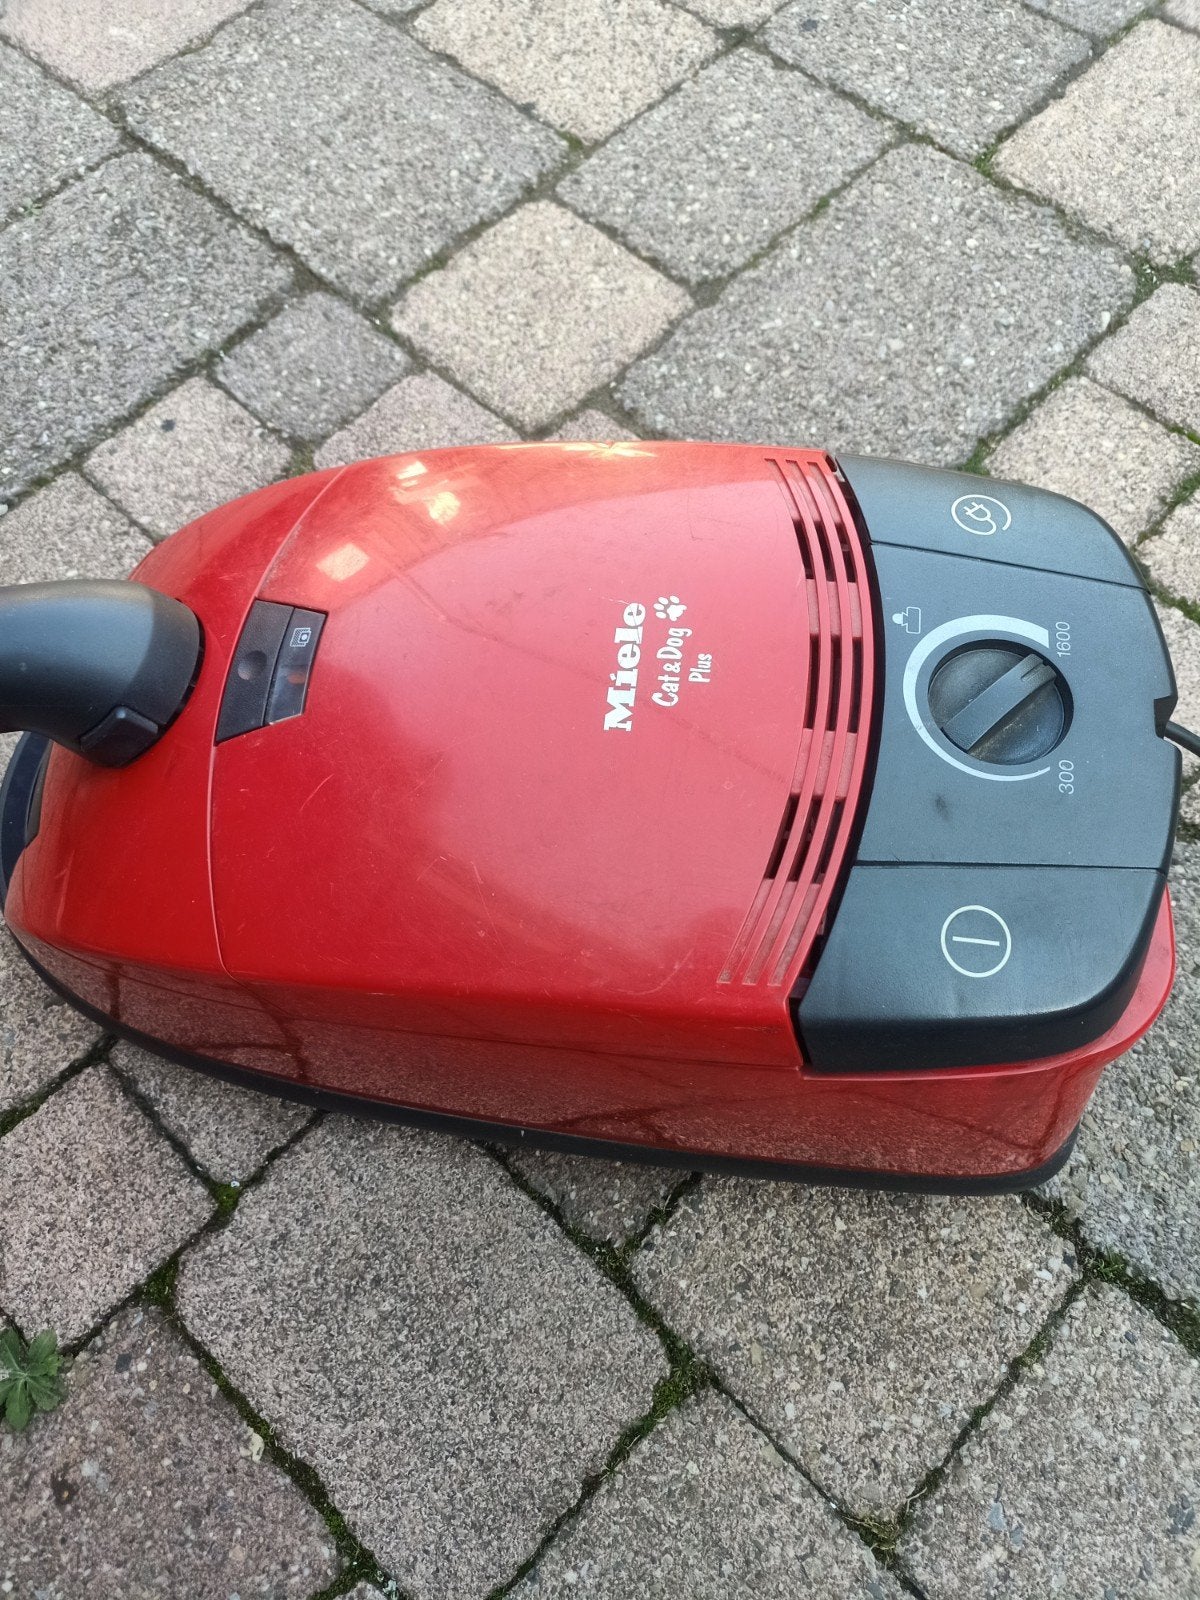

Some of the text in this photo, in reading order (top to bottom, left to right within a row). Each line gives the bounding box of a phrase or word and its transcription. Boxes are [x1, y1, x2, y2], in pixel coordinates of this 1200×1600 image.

[656, 627, 693, 660] Dog
[1055, 621, 1071, 658] 1600
[603, 602, 646, 732] Miele
[688, 653, 713, 683] Plus
[651, 674, 681, 707] Cat
[1058, 759, 1075, 795] 300
